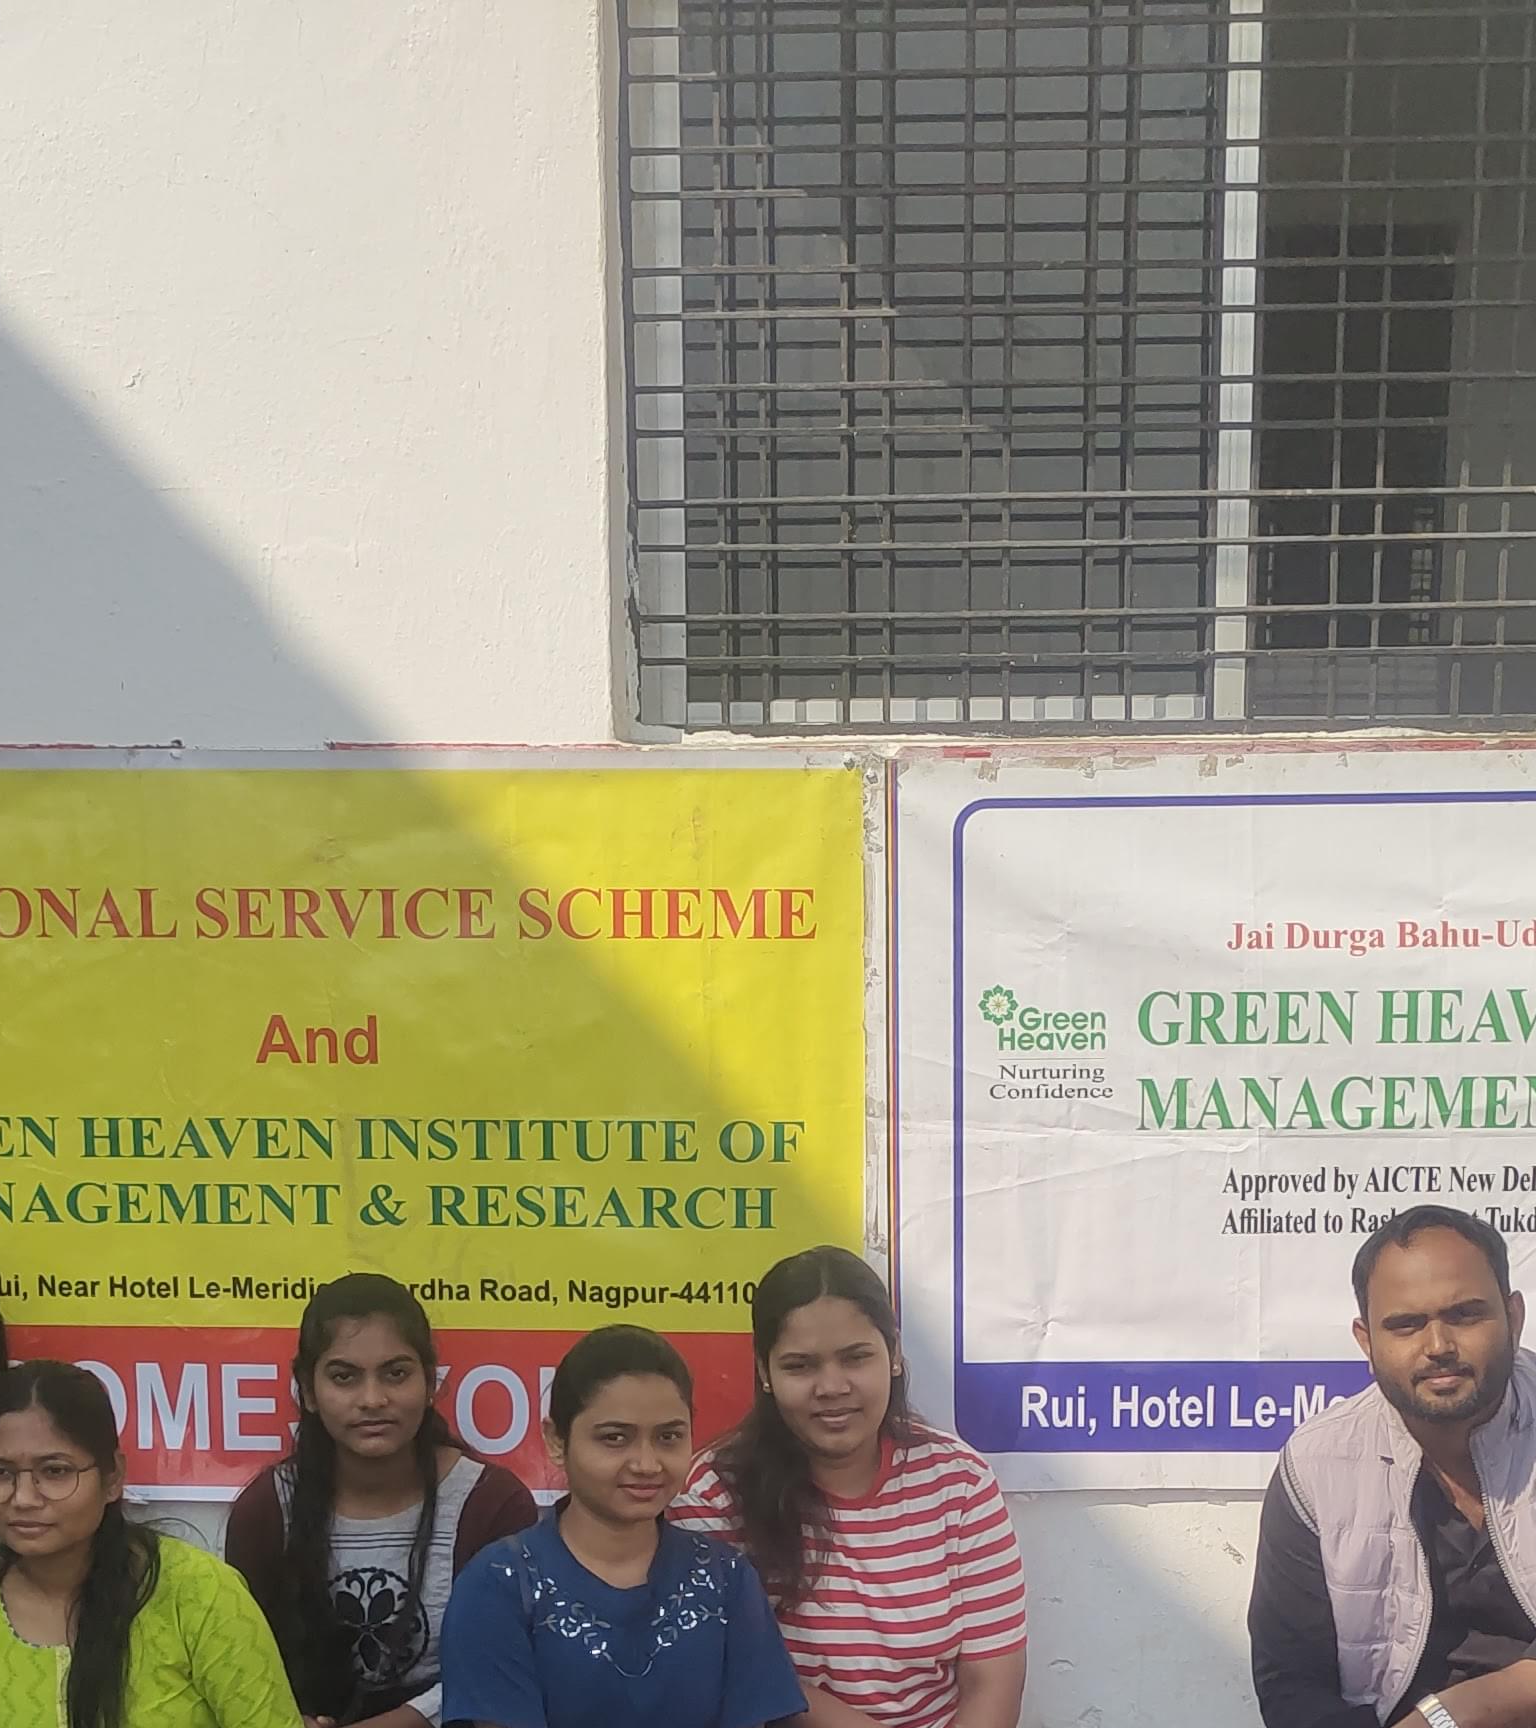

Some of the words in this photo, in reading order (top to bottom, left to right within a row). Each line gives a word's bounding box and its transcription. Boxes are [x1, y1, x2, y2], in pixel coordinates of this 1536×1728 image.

[196, 888, 495, 940] SERVICE
[518, 888, 817, 940] SCHEME
[1227, 921, 1274, 951] Jai
[1284, 921, 1385, 957] Durga
[1019, 1007, 1106, 1030] Green
[1137, 989, 1356, 1046] GREEN
[256, 1015, 380, 1064] And
[999, 1028, 1106, 1050] Heaven
[999, 1064, 1105, 1082] Nurturing
[990, 1084, 1113, 1099] Confidence
[81, 1115, 334, 1160] HEAVEN
[356, 1118, 699, 1164] INSTITUTE
[719, 1121, 805, 1164] OF
[1223, 1167, 1326, 1200] Approved
[1333, 1166, 1358, 1199] by
[1364, 1167, 1441, 1193] AICTE
[1448, 1167, 1496, 1193] New
[359, 1185, 408, 1227] &
[427, 1185, 776, 1230] RESEARCH
[1222, 1207, 1317, 1234] Affiliated
[1323, 1208, 1343, 1233] to
[38, 1275, 100, 1298] Near
[110, 1276, 179, 1298] Hotel
[480, 1280, 558, 1305] Road,
[569, 1281, 756, 1308] Nagpur-44110
[1021, 1385, 1097, 1437] Rui,
[1112, 1385, 1214, 1427] Hotel
